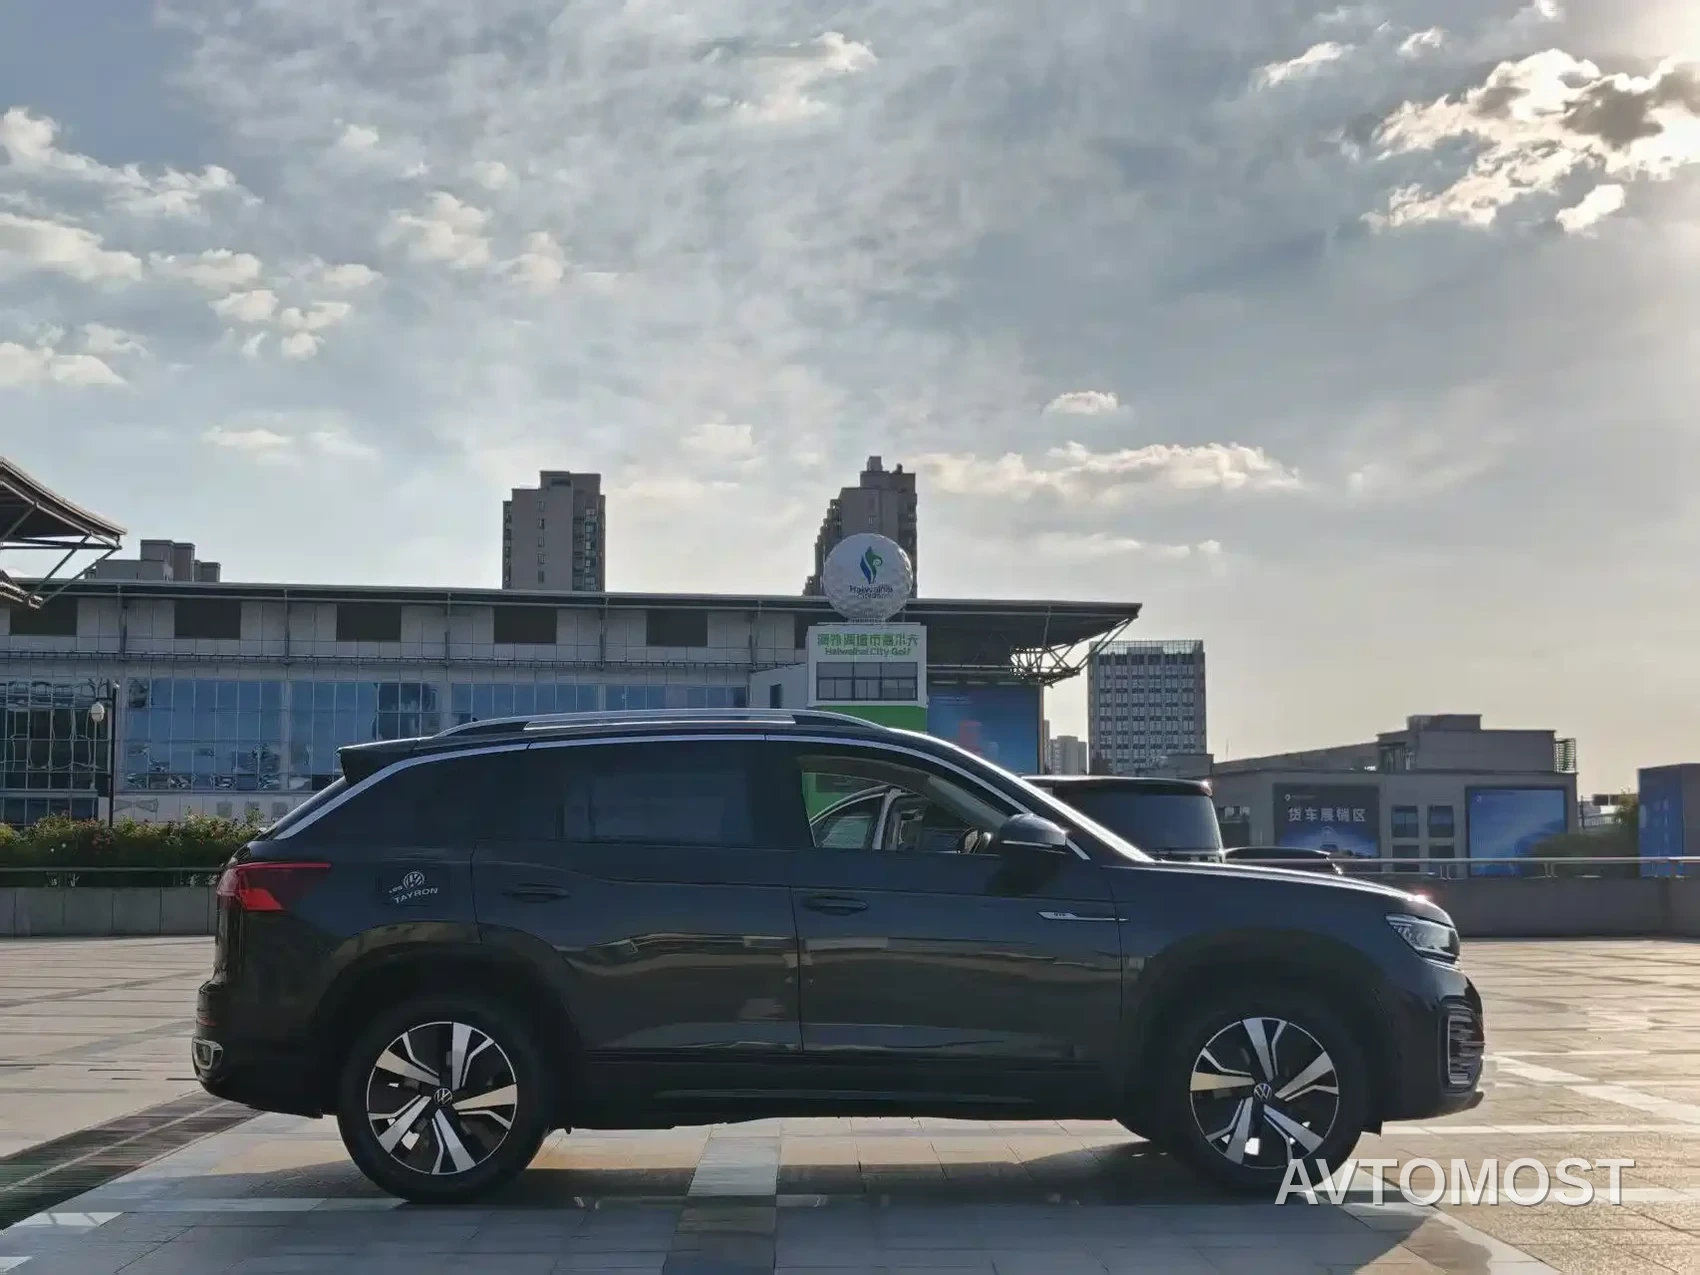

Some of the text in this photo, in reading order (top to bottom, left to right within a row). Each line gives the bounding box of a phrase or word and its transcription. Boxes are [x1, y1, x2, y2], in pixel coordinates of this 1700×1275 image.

[870, 648, 889, 657] City
[1287, 807, 1366, 822] 货车展销区
[394, 887, 438, 904] TAYRON
